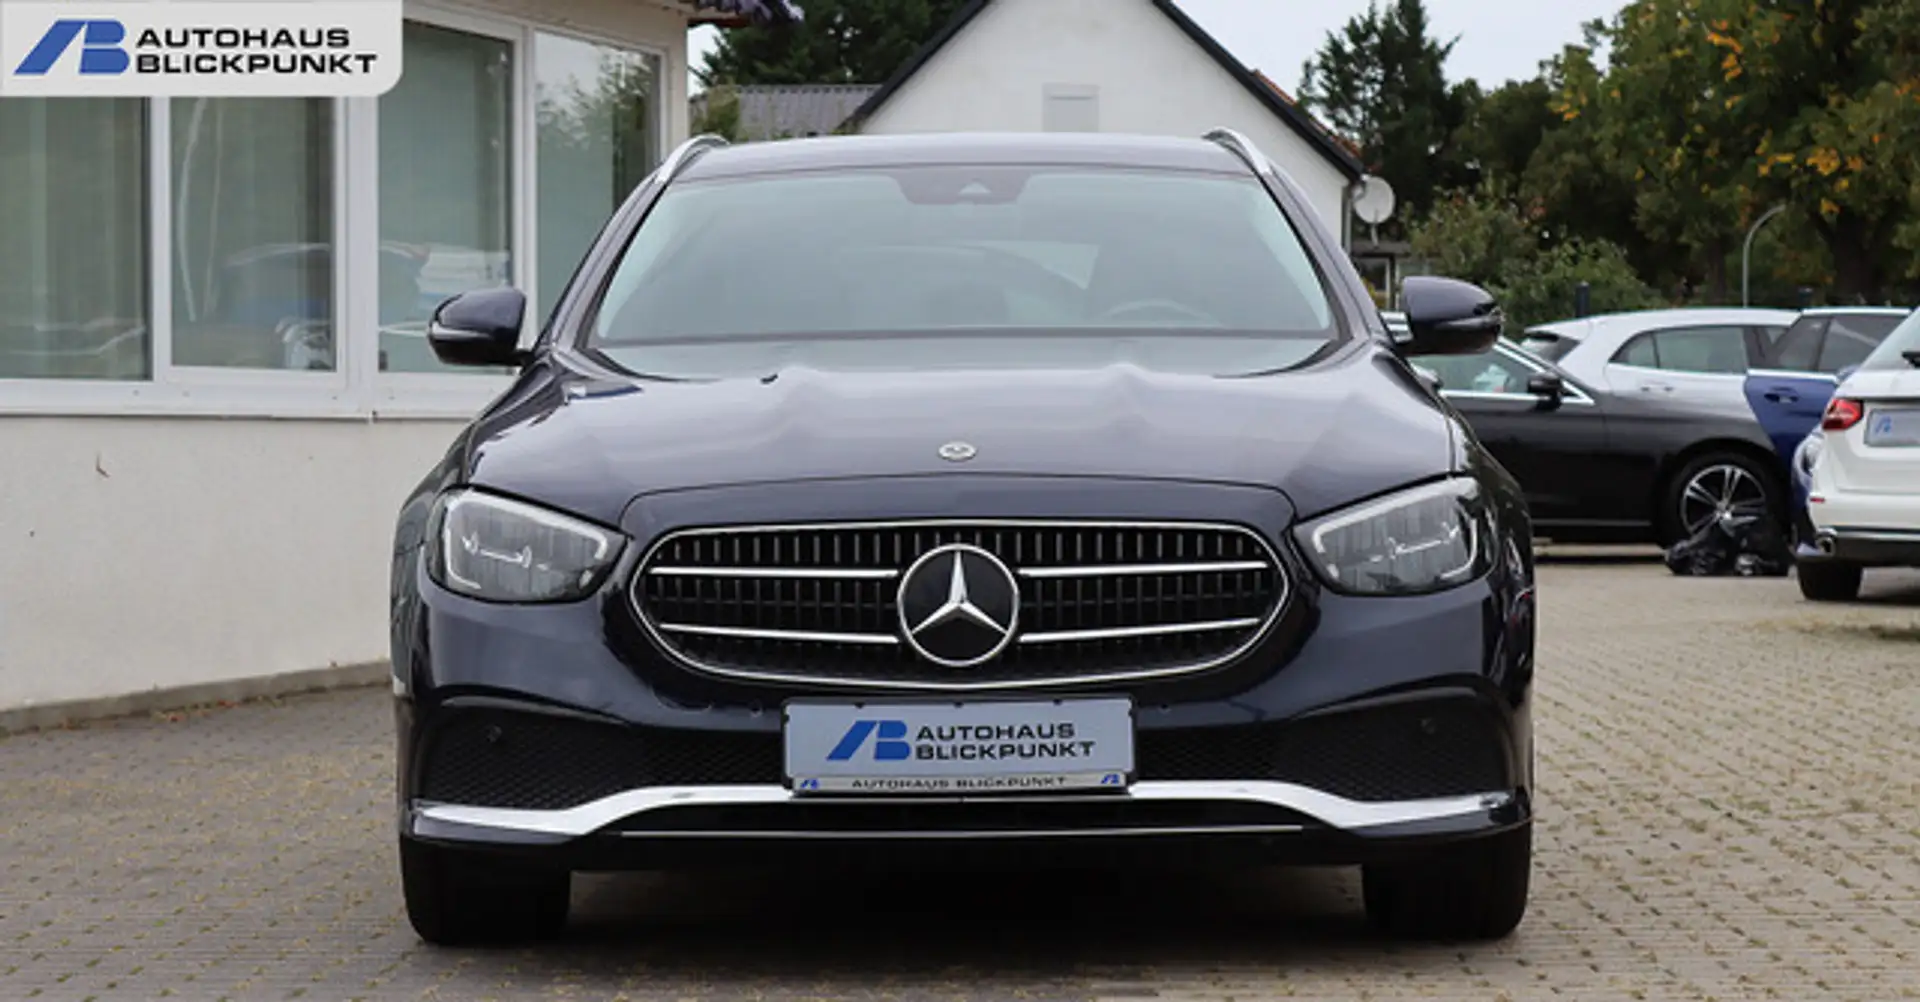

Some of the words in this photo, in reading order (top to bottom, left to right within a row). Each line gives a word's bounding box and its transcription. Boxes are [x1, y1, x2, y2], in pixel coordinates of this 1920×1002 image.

[915, 722, 1076, 741] AUTOHAUS
[915, 741, 1097, 761] BLICKPUNKT
[851, 779, 950, 789] AUTOHAUS
[956, 776, 1068, 788] BLICKPUNKT
